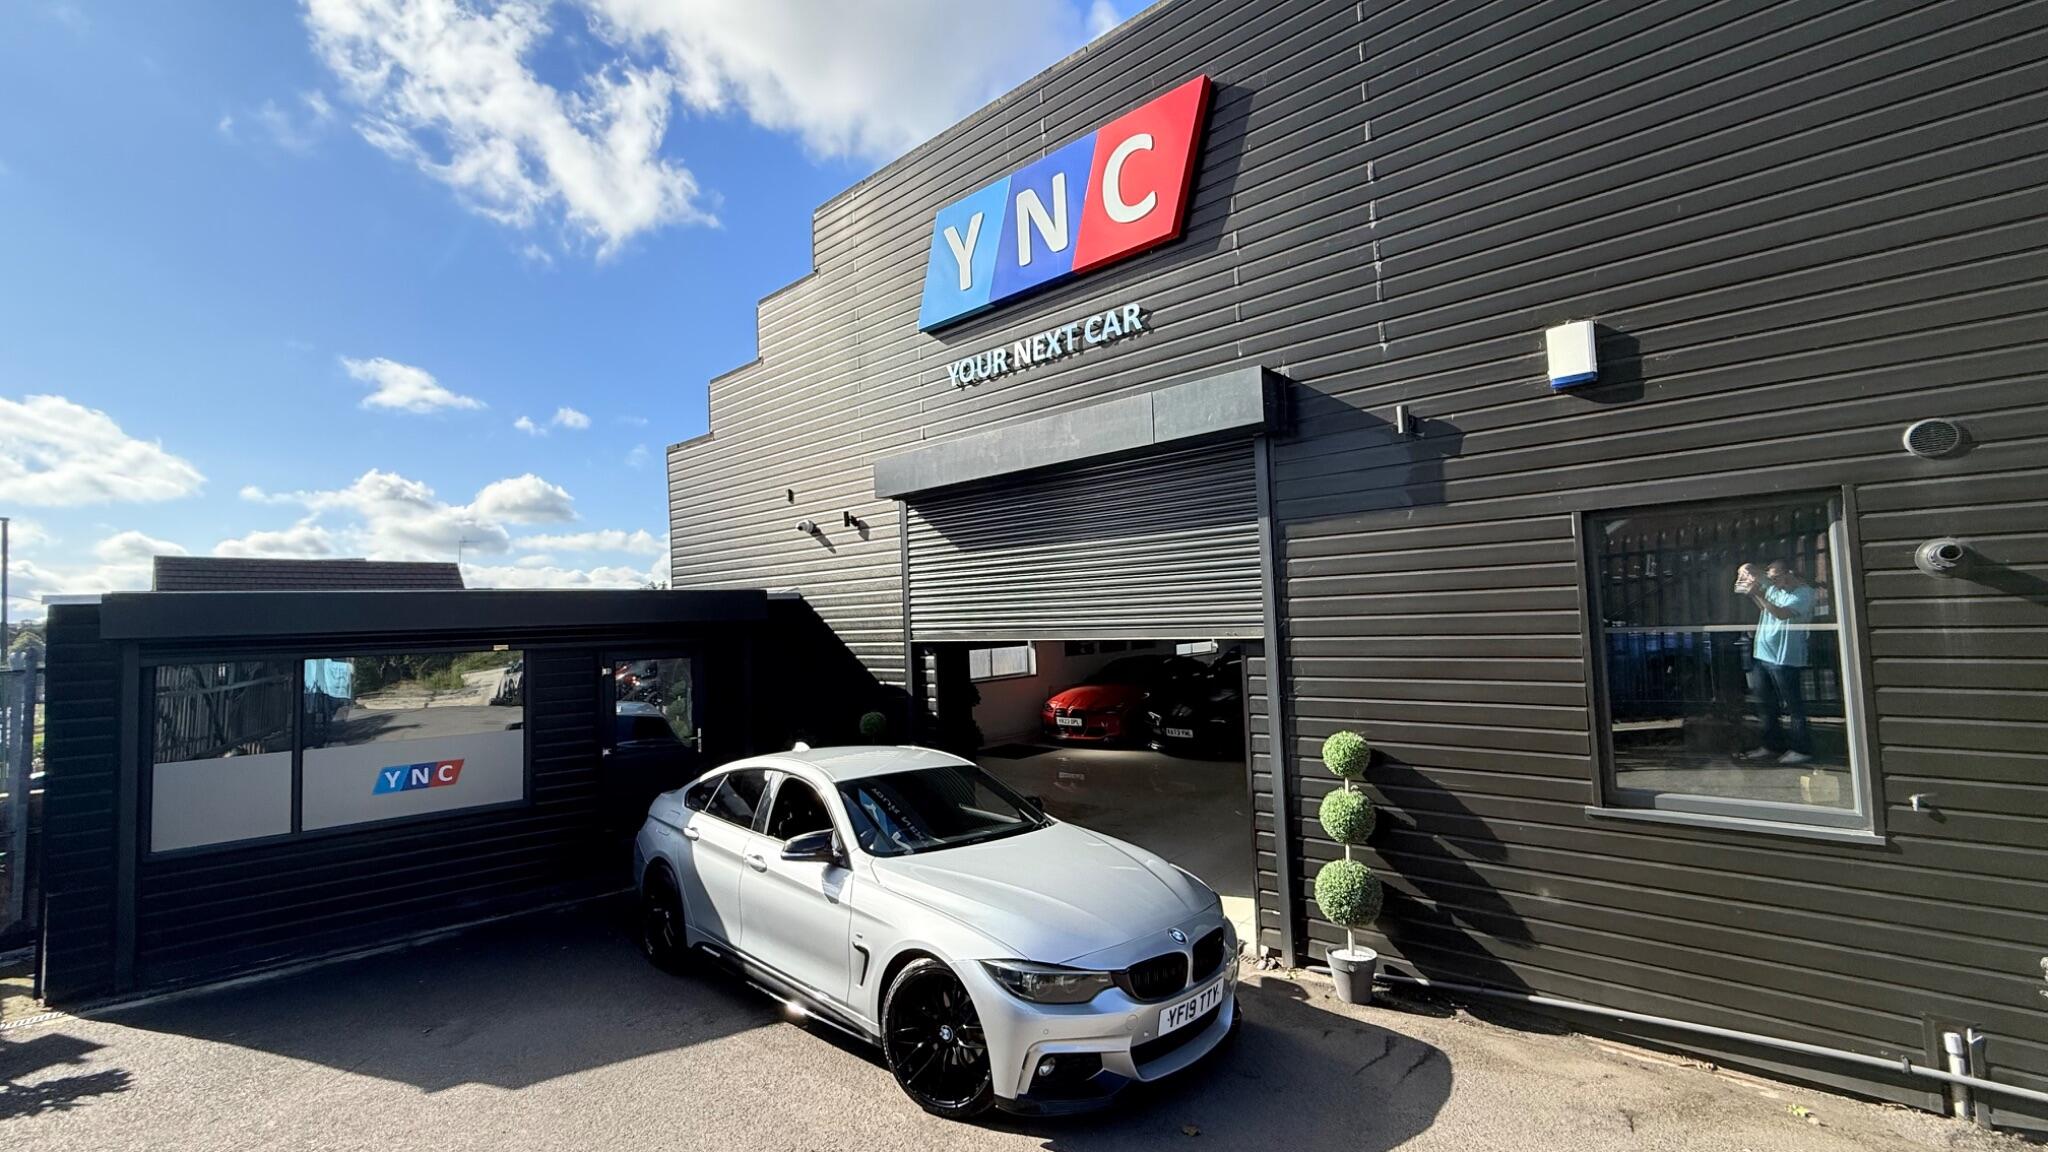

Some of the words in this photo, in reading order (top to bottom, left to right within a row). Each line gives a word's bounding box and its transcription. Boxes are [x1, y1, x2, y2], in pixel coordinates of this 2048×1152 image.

[943, 133, 1158, 291] YNC
[946, 348, 1008, 387] YOUR
[1013, 321, 1079, 368] NEXT
[1084, 303, 1143, 344] CAR
[384, 764, 453, 788] YNC
[1169, 999, 1197, 1028] YF19
[1200, 984, 1219, 1012] TTY
